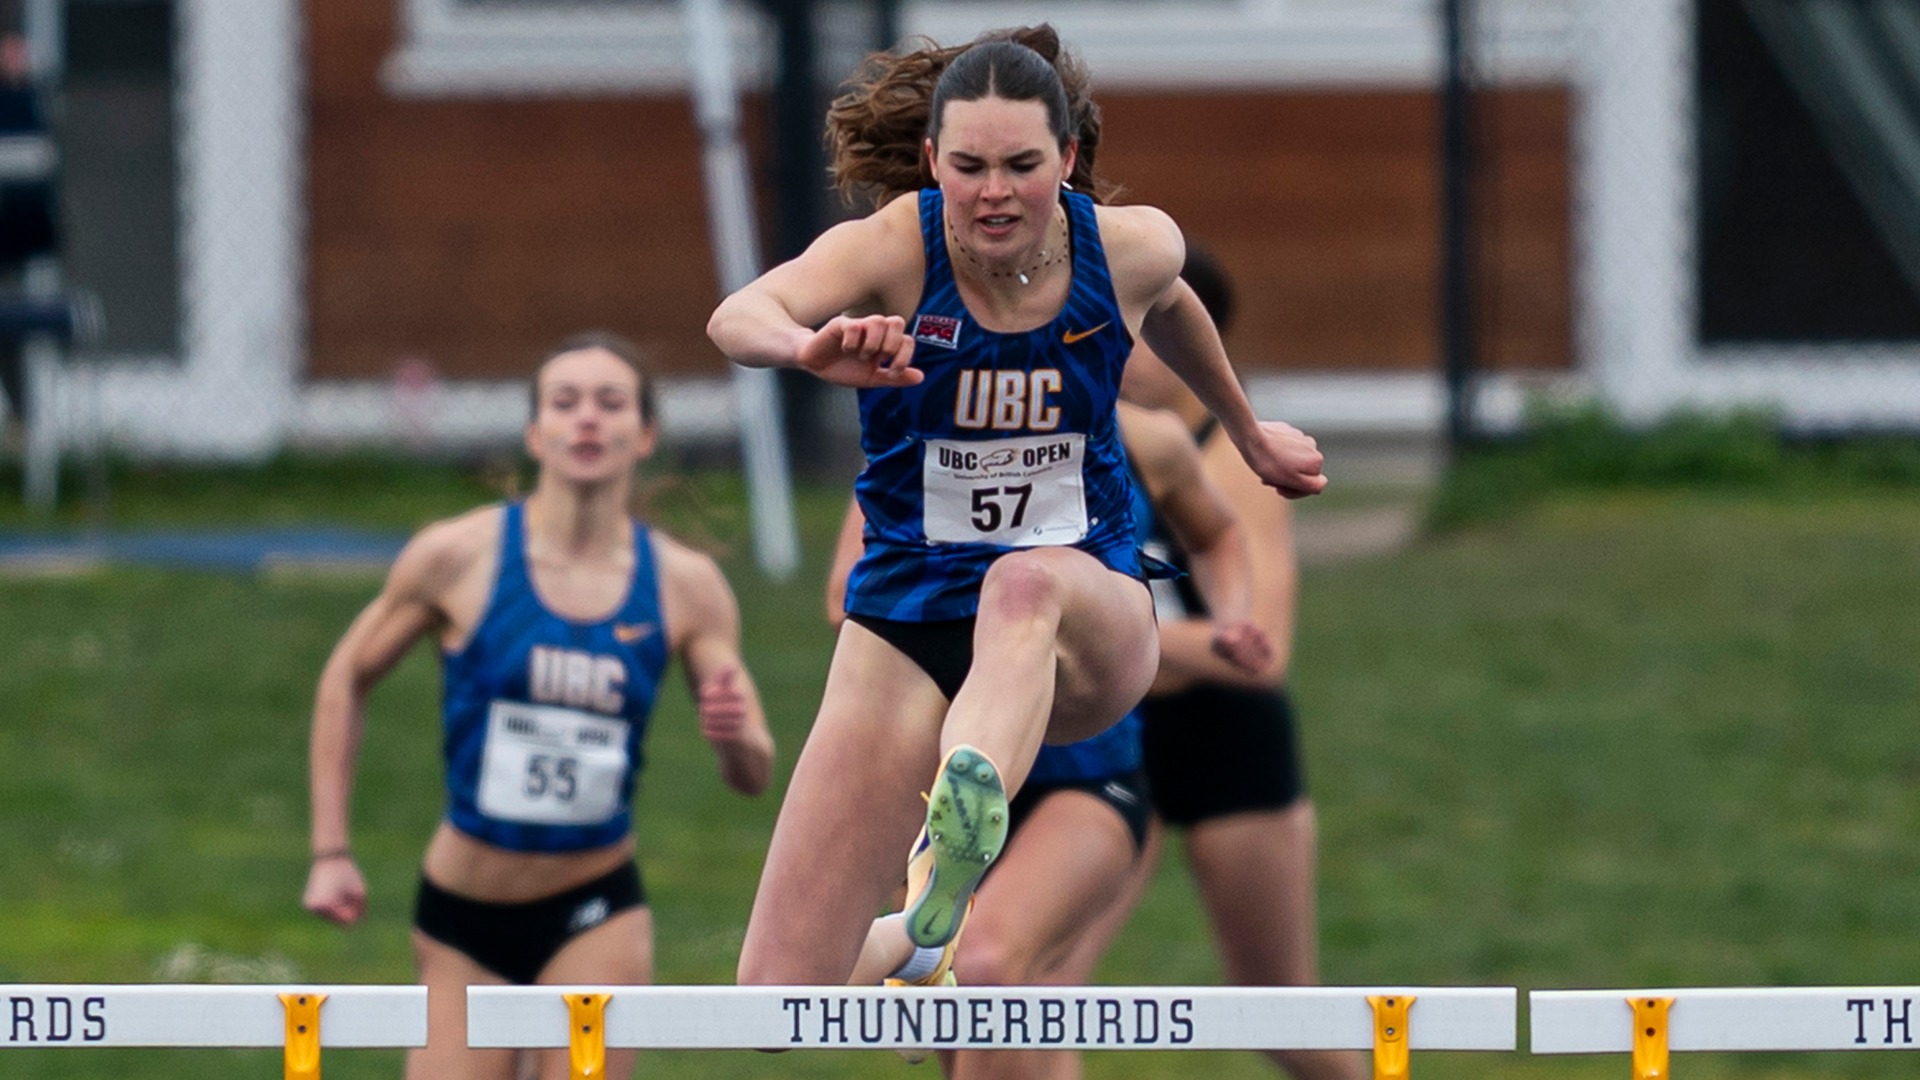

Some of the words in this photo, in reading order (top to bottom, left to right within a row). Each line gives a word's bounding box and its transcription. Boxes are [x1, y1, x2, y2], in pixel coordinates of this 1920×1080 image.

[954, 368, 1062, 431] UBC
[938, 446, 978, 471] UBC
[1023, 442, 1071, 468] OPEN
[971, 482, 1033, 533] 57
[530, 646, 626, 715] UBC
[526, 754, 578, 804] 55
[9, 996, 106, 1042] RDS
[782, 997, 1194, 1045] THUNDERBIRDS
[1846, 998, 1912, 1044] TH
